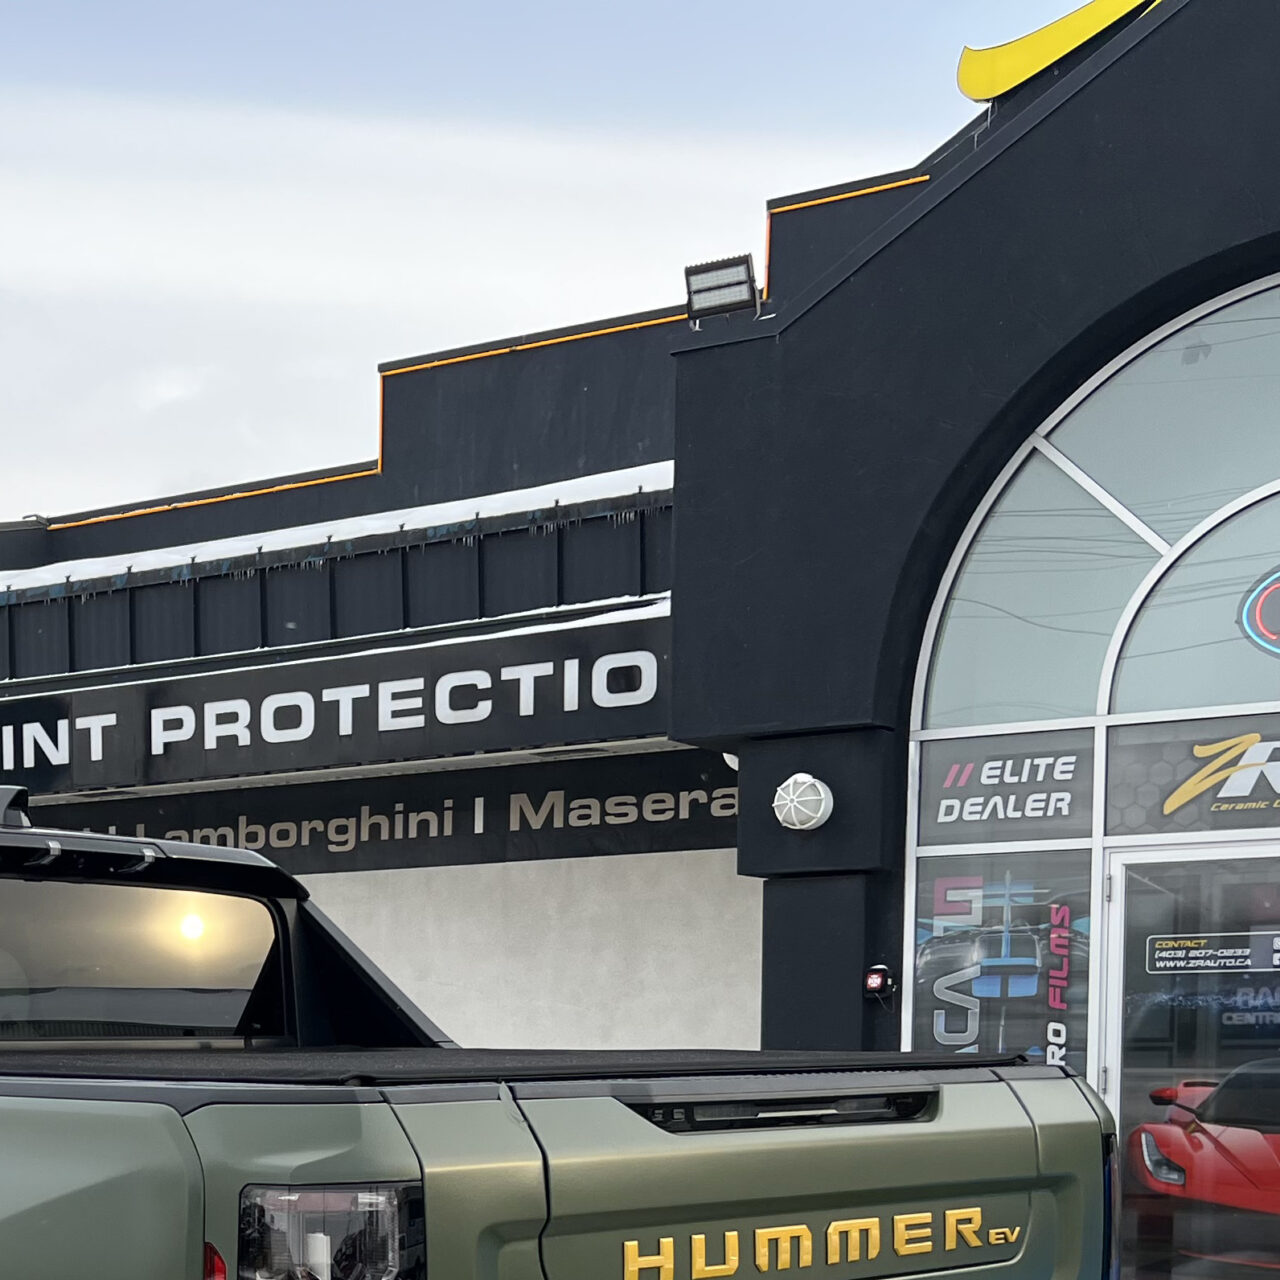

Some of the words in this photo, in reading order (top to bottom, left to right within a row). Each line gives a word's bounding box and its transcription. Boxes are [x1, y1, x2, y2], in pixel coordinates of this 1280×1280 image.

[150, 650, 658, 755] PROTECTIO
[980, 755, 1077, 785] ELITE
[937, 791, 1071, 823] DEALER
[1210, 800, 1269, 812] Ceramic
[135, 799, 454, 852] mborghini
[509, 786, 738, 832] Masera
[1154, 950, 1186, 959] (403)
[1188, 948, 1251, 957] 207-0233
[1155, 940, 1208, 948] CONTACT
[1048, 904, 1070, 1010] FILMS
[1155, 958, 1252, 968] WWW.ZRAUTO.CA
[989, 1226, 1021, 1245] EV
